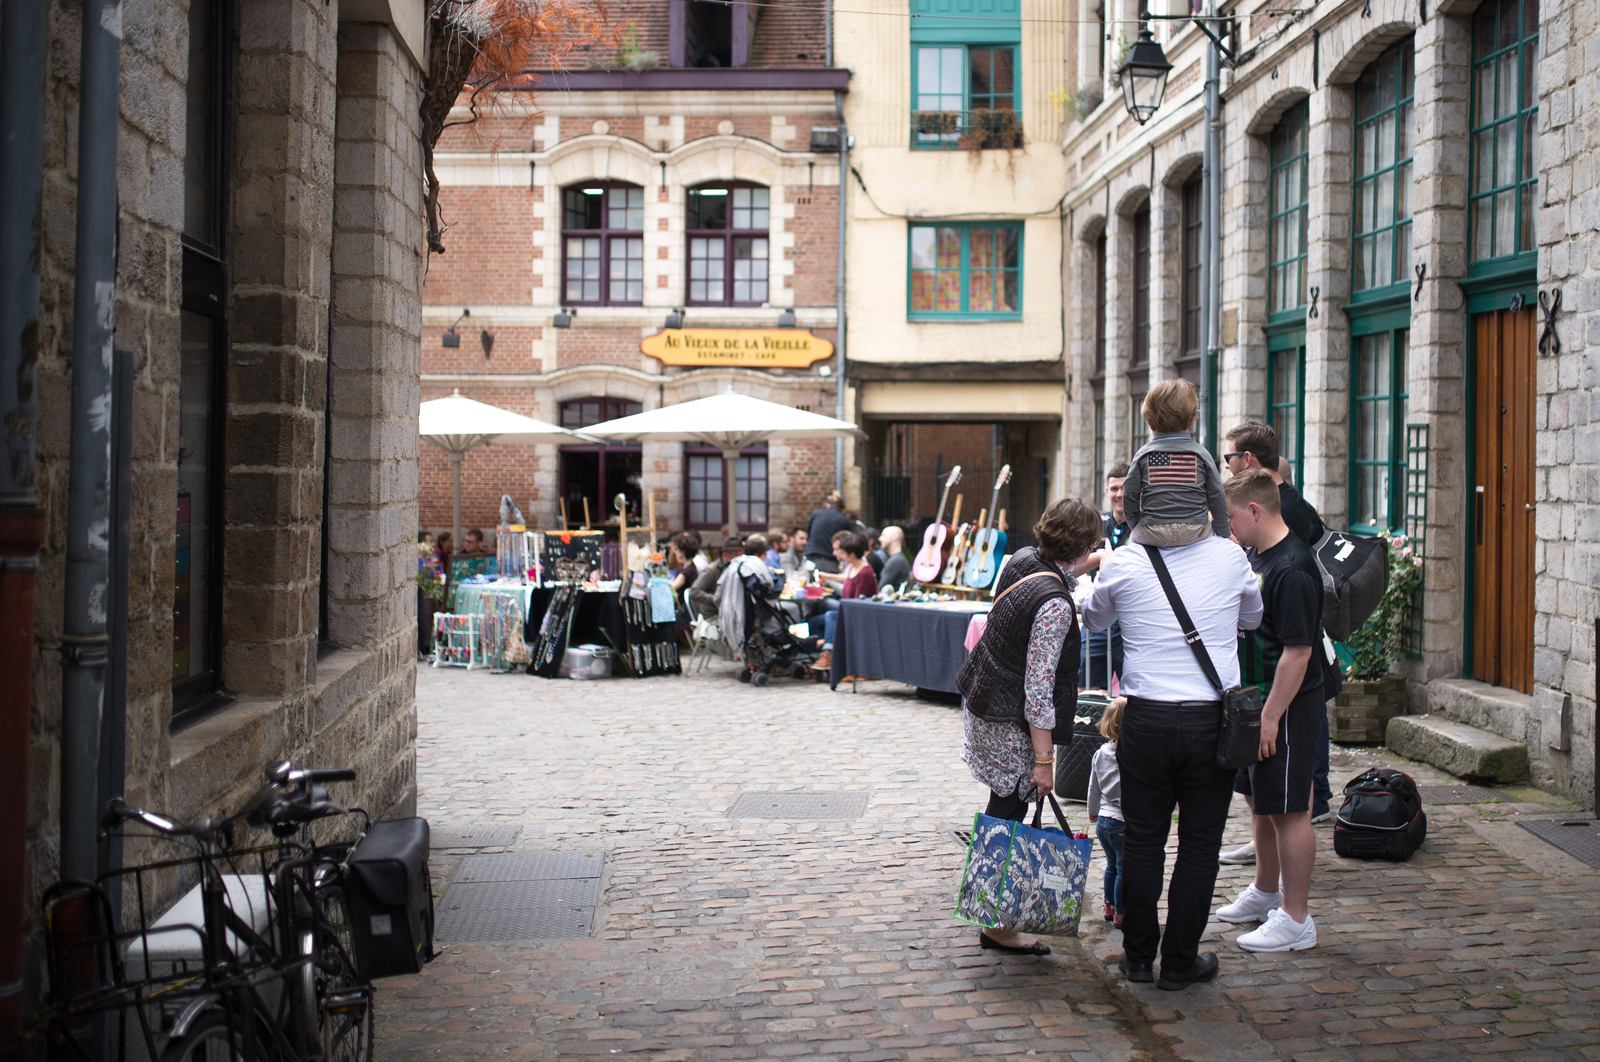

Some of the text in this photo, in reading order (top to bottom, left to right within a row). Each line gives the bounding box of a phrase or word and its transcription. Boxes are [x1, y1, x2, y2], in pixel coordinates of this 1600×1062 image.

[664, 335, 811, 351] AU VIEUX DE LA VIEILLE
